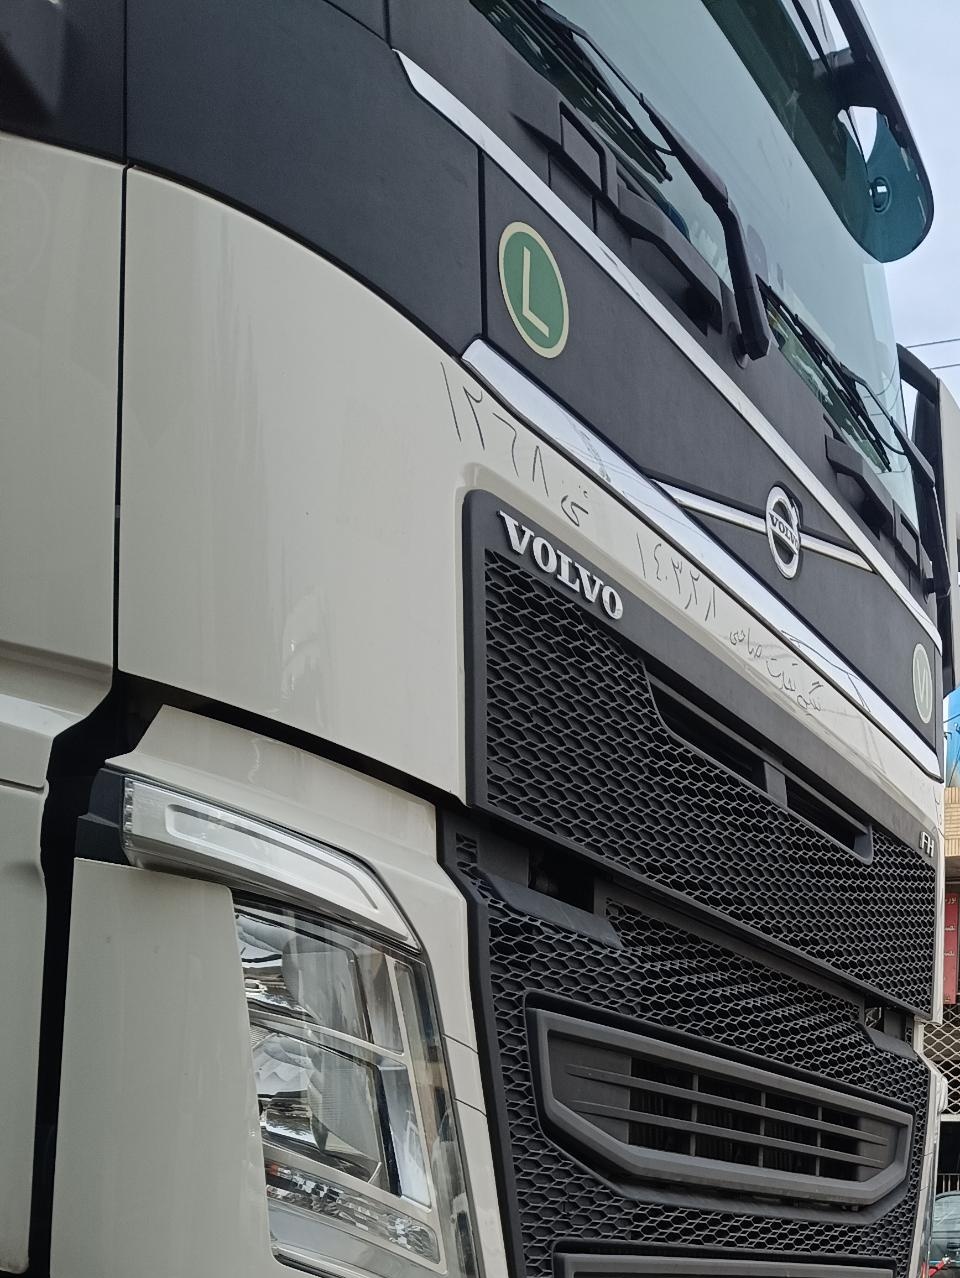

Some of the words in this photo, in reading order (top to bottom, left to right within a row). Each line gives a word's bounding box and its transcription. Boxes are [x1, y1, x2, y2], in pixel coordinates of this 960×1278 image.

[522, 246, 550, 338] L
[769, 512, 799, 550] VOLVO
[498, 510, 623, 620] VOLVO
[920, 831, 934, 857] FH
